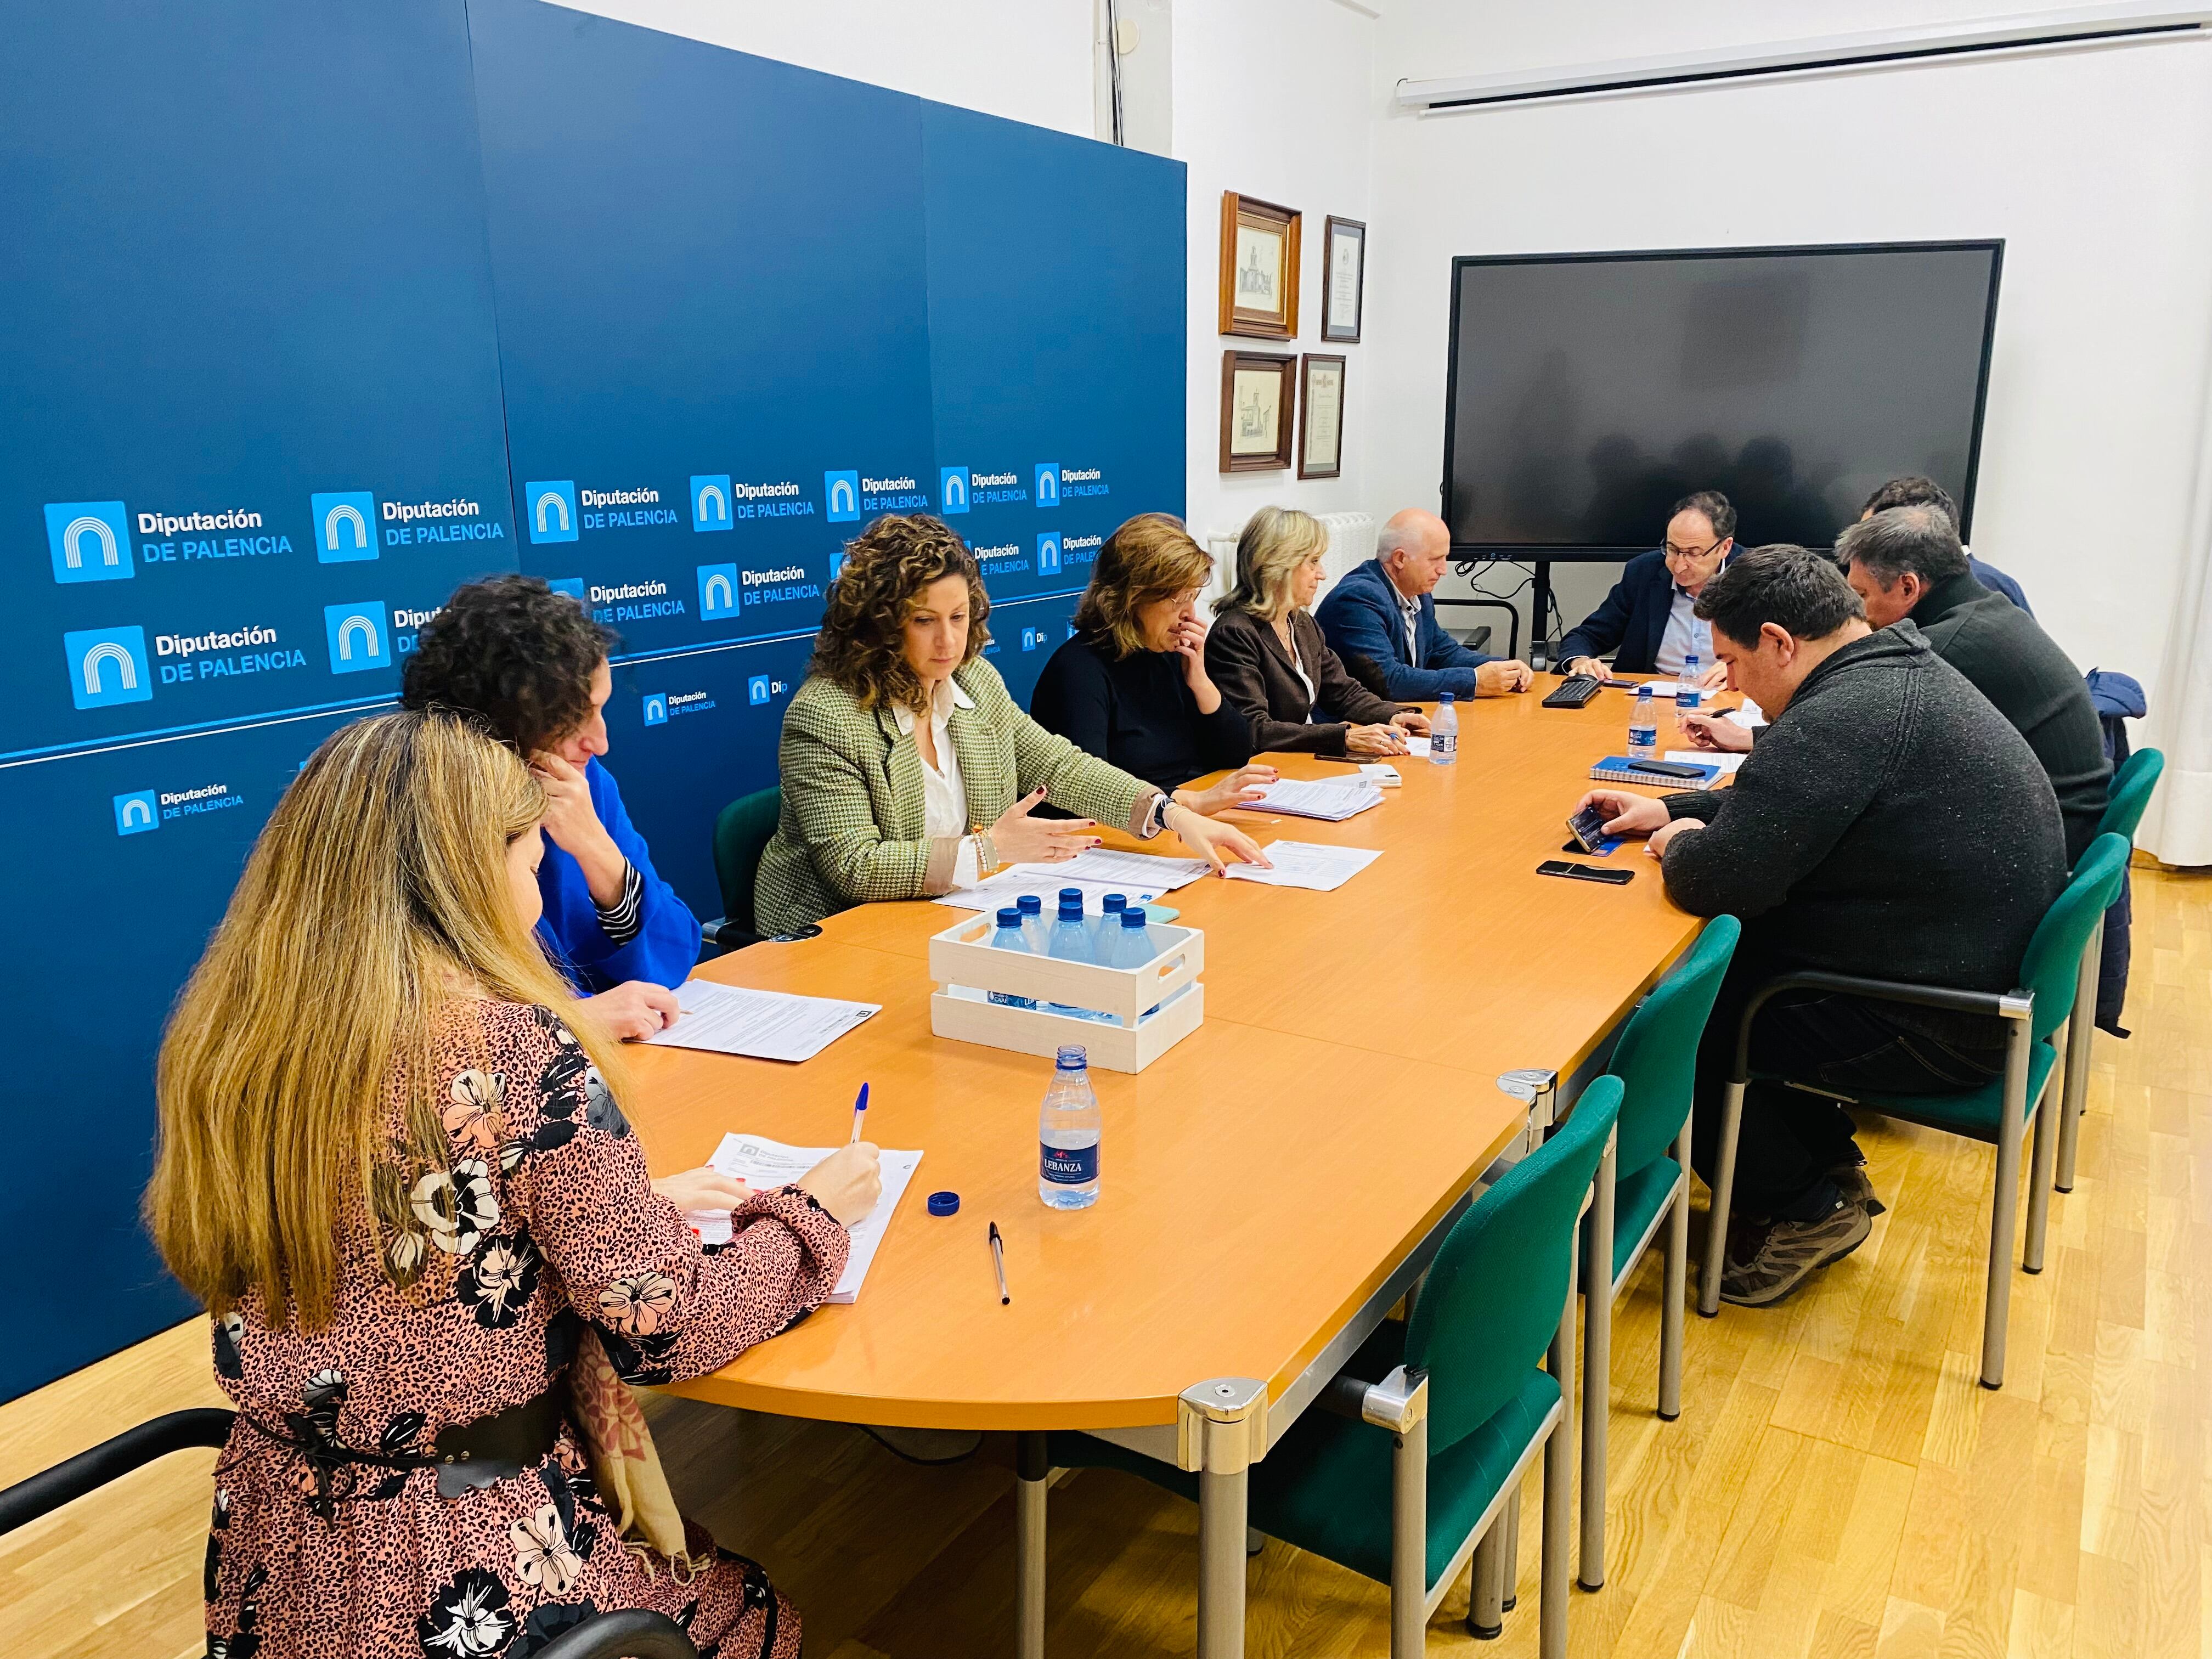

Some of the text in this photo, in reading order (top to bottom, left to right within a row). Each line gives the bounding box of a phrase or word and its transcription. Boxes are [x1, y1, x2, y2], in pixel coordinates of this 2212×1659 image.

[862, 476, 915, 493] Diputación
[972, 472, 1017, 488] Diputación
[1062, 468, 1101, 483] Diputación
[582, 487, 659, 508] Diputación
[736, 482, 799, 500] Diputación
[973, 489, 1027, 504] DE PALENCIA
[1063, 484, 1109, 498] DE PALENCIA
[382, 498, 479, 522] Diputación
[738, 501, 814, 518] DE PALENCIA
[864, 495, 928, 511] DE PALENCIA
[138, 509, 262, 535] Diputación
[584, 510, 678, 529] DE PALENCIA
[386, 522, 505, 545] DE PALENCIA
[1063, 534, 1102, 549] Diputación
[143, 535, 292, 562] DE PALENCIA
[974, 543, 1019, 561] Diputación
[981, 560, 1029, 575] E PALENCIA
[1064, 554, 1074, 565] DE
[742, 566, 804, 586] Diputación
[590, 580, 667, 604] Diputación
[744, 584, 820, 606] DE PALENCIA
[593, 600, 685, 623] DE PALENCIA
[156, 625, 276, 657] Diputación
[161, 648, 307, 684] DE PALENCIA
[771, 681, 788, 695] Dip
[669, 691, 707, 706] Diputación
[670, 700, 716, 716] DE PALENCIA
[161, 784, 227, 805] Diputación
[163, 795, 244, 819] DE PALENCIA
[1044, 1158, 1082, 1172] LEBANZA
